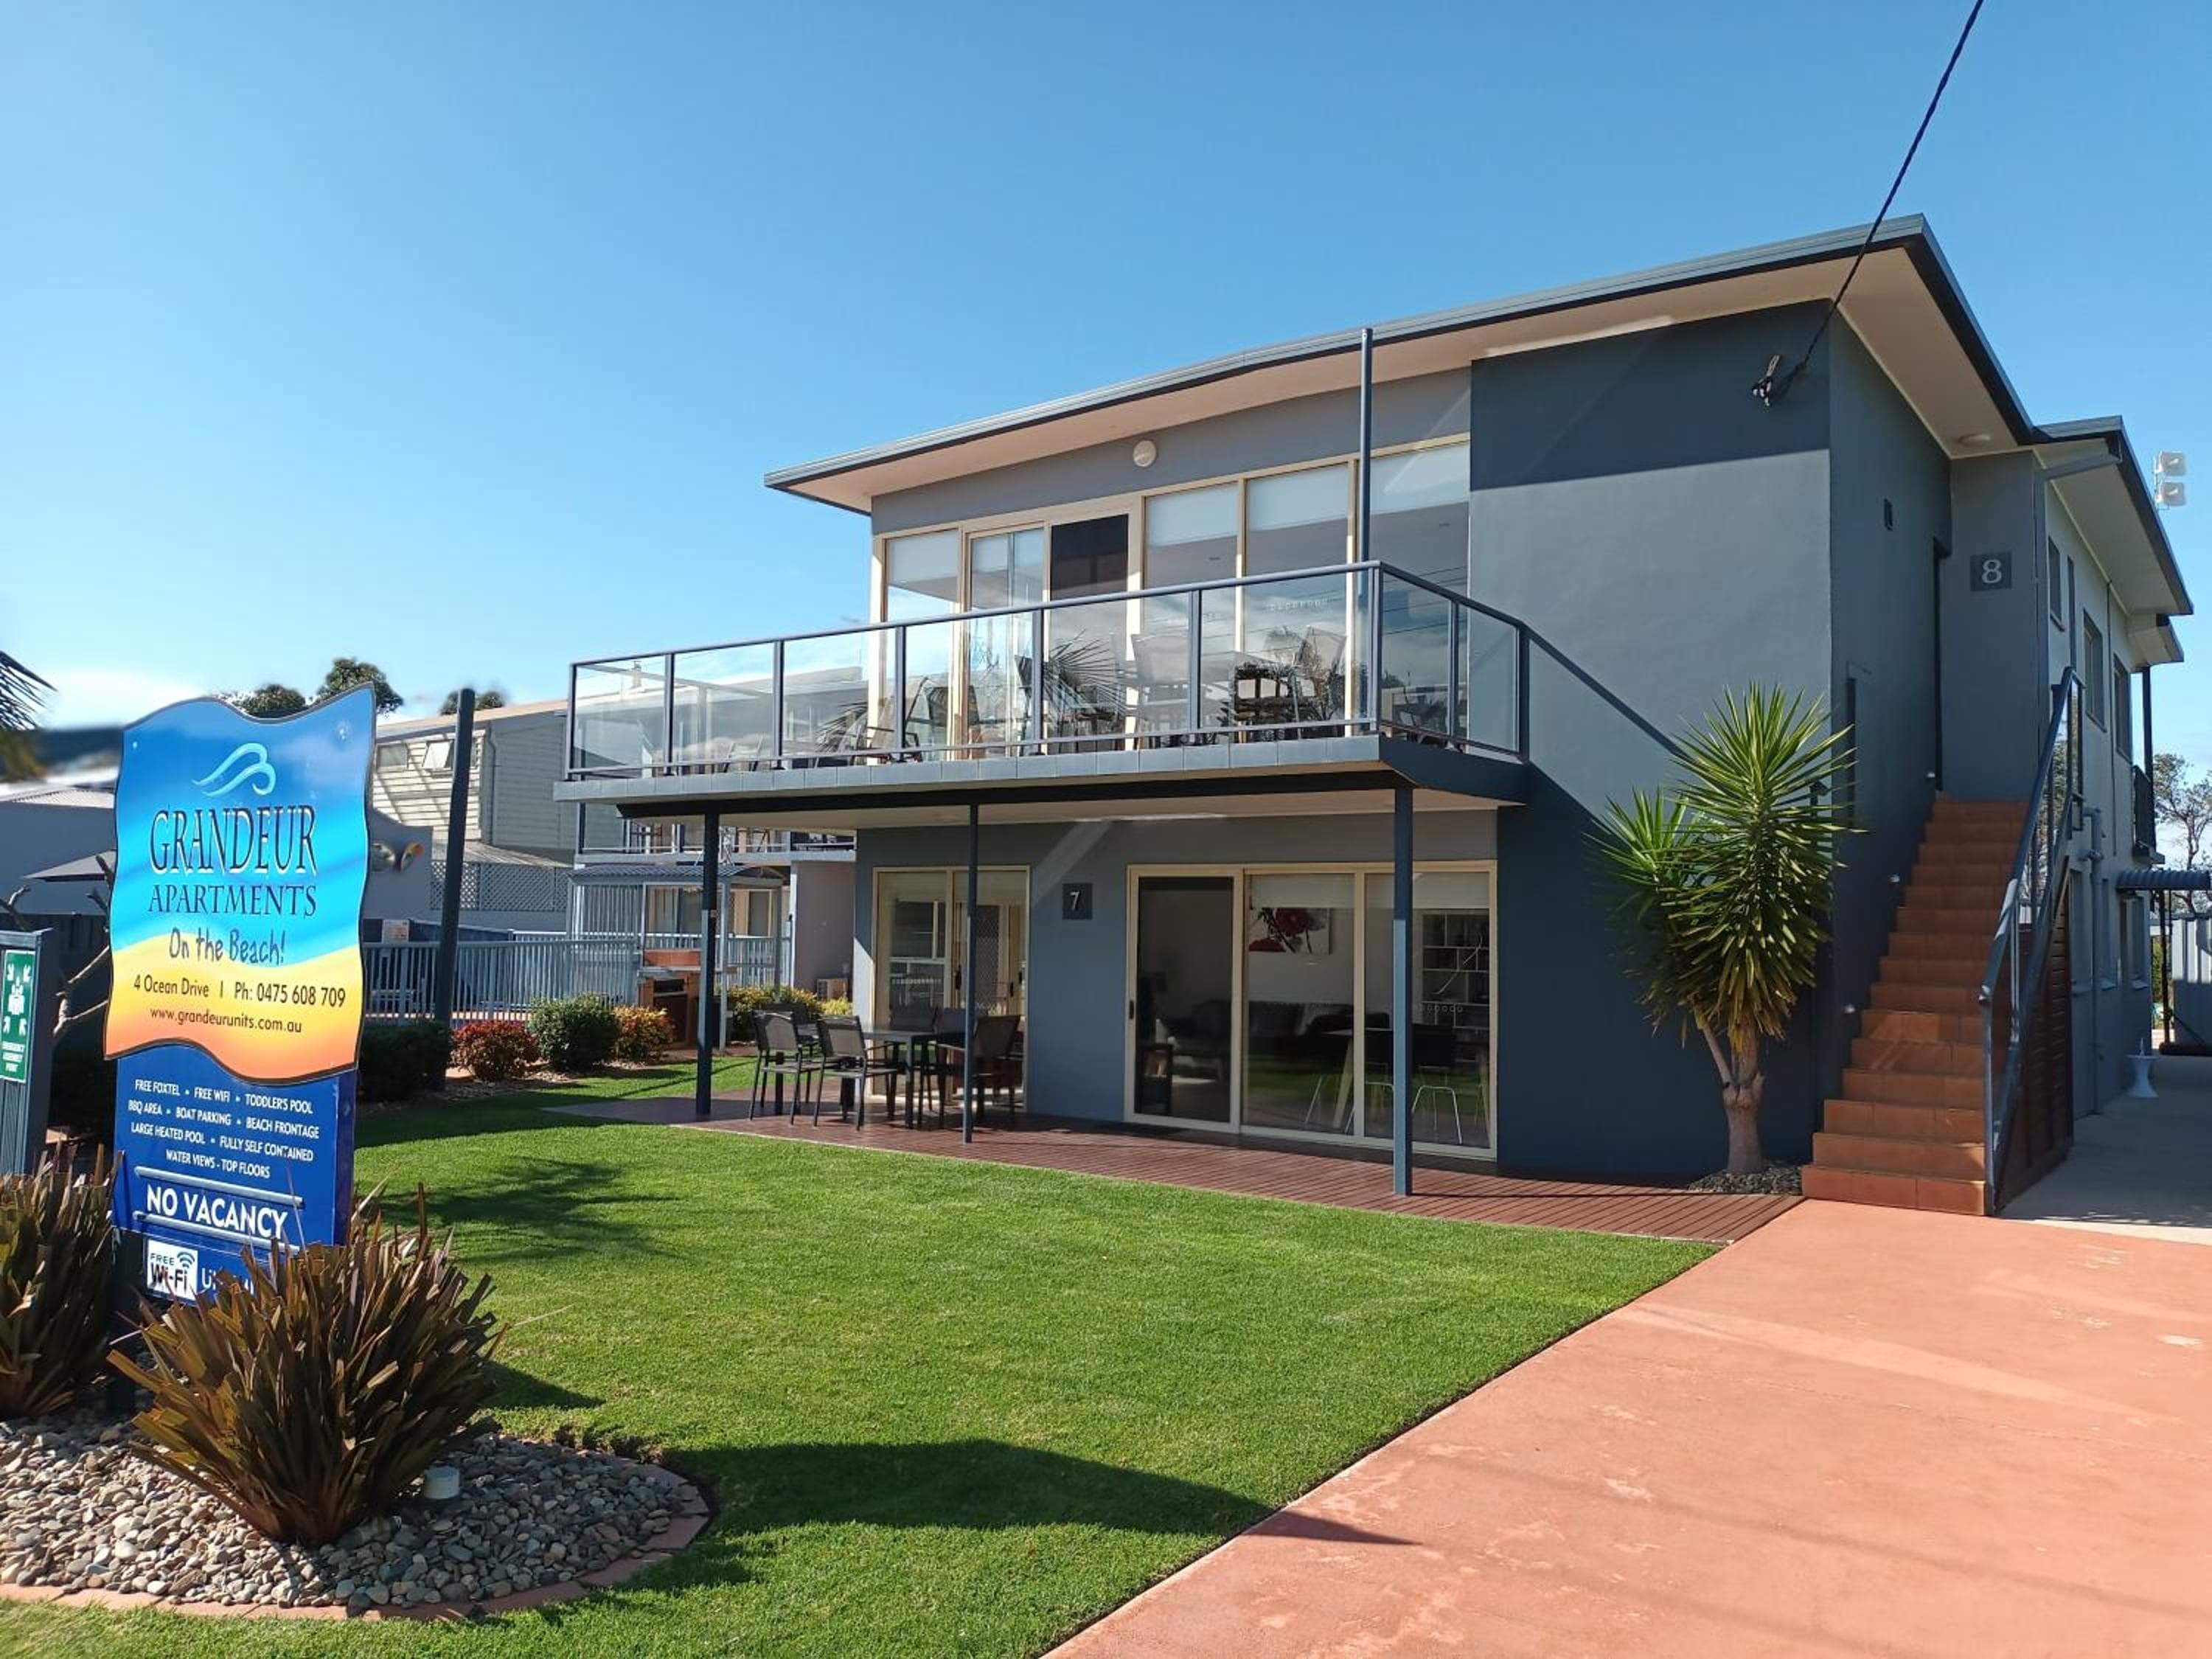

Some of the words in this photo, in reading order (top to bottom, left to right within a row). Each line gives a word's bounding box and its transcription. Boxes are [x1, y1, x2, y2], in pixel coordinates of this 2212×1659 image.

[1981, 559, 2003, 583] 8
[150, 804, 318, 876] GRANDEUR
[147, 884, 317, 918] APARTMENTS
[1070, 891, 1080, 911] 7
[169, 927, 189, 959] On
[195, 927, 223, 961] the
[229, 928, 286, 965] Beach!
[133, 973, 141, 991] 4
[144, 974, 178, 995] Ocean
[181, 977, 209, 997] Drive
[234, 981, 253, 1001] Ph:
[257, 982, 288, 1004] 0475
[291, 985, 316, 1005] 608
[321, 987, 347, 1007] 709
[150, 1008, 302, 1033] www.grandeurunits.com.au
[135, 1079, 152, 1092] FREE
[153, 1082, 181, 1096] FOXTEL
[194, 1086, 212, 1100] FREE
[290, 1099, 313, 1114] POOL
[128, 1099, 142, 1114] BBQ
[144, 1102, 163, 1116] AREA
[175, 1107, 196, 1119] BOAT
[197, 1109, 232, 1126] PARKING
[246, 1116, 273, 1133] BEACH
[274, 1120, 319, 1139] FRONTAGE
[131, 1121, 153, 1136] LARGE
[154, 1124, 184, 1141] HEATED
[184, 1130, 206, 1144] POOL
[219, 1135, 244, 1150] FULLY
[244, 1139, 263, 1154] SELF
[264, 1142, 314, 1161] CONTAINED
[166, 1148, 192, 1164] WATER
[192, 1153, 215, 1169] VIEWS
[220, 1158, 238, 1172] TOP
[238, 1161, 271, 1178] FLOORS
[147, 1183, 178, 1217] NO
[184, 1191, 288, 1239] VACANCY
[150, 1253, 175, 1266] FREE
[150, 1263, 188, 1294] Wi-Fi
